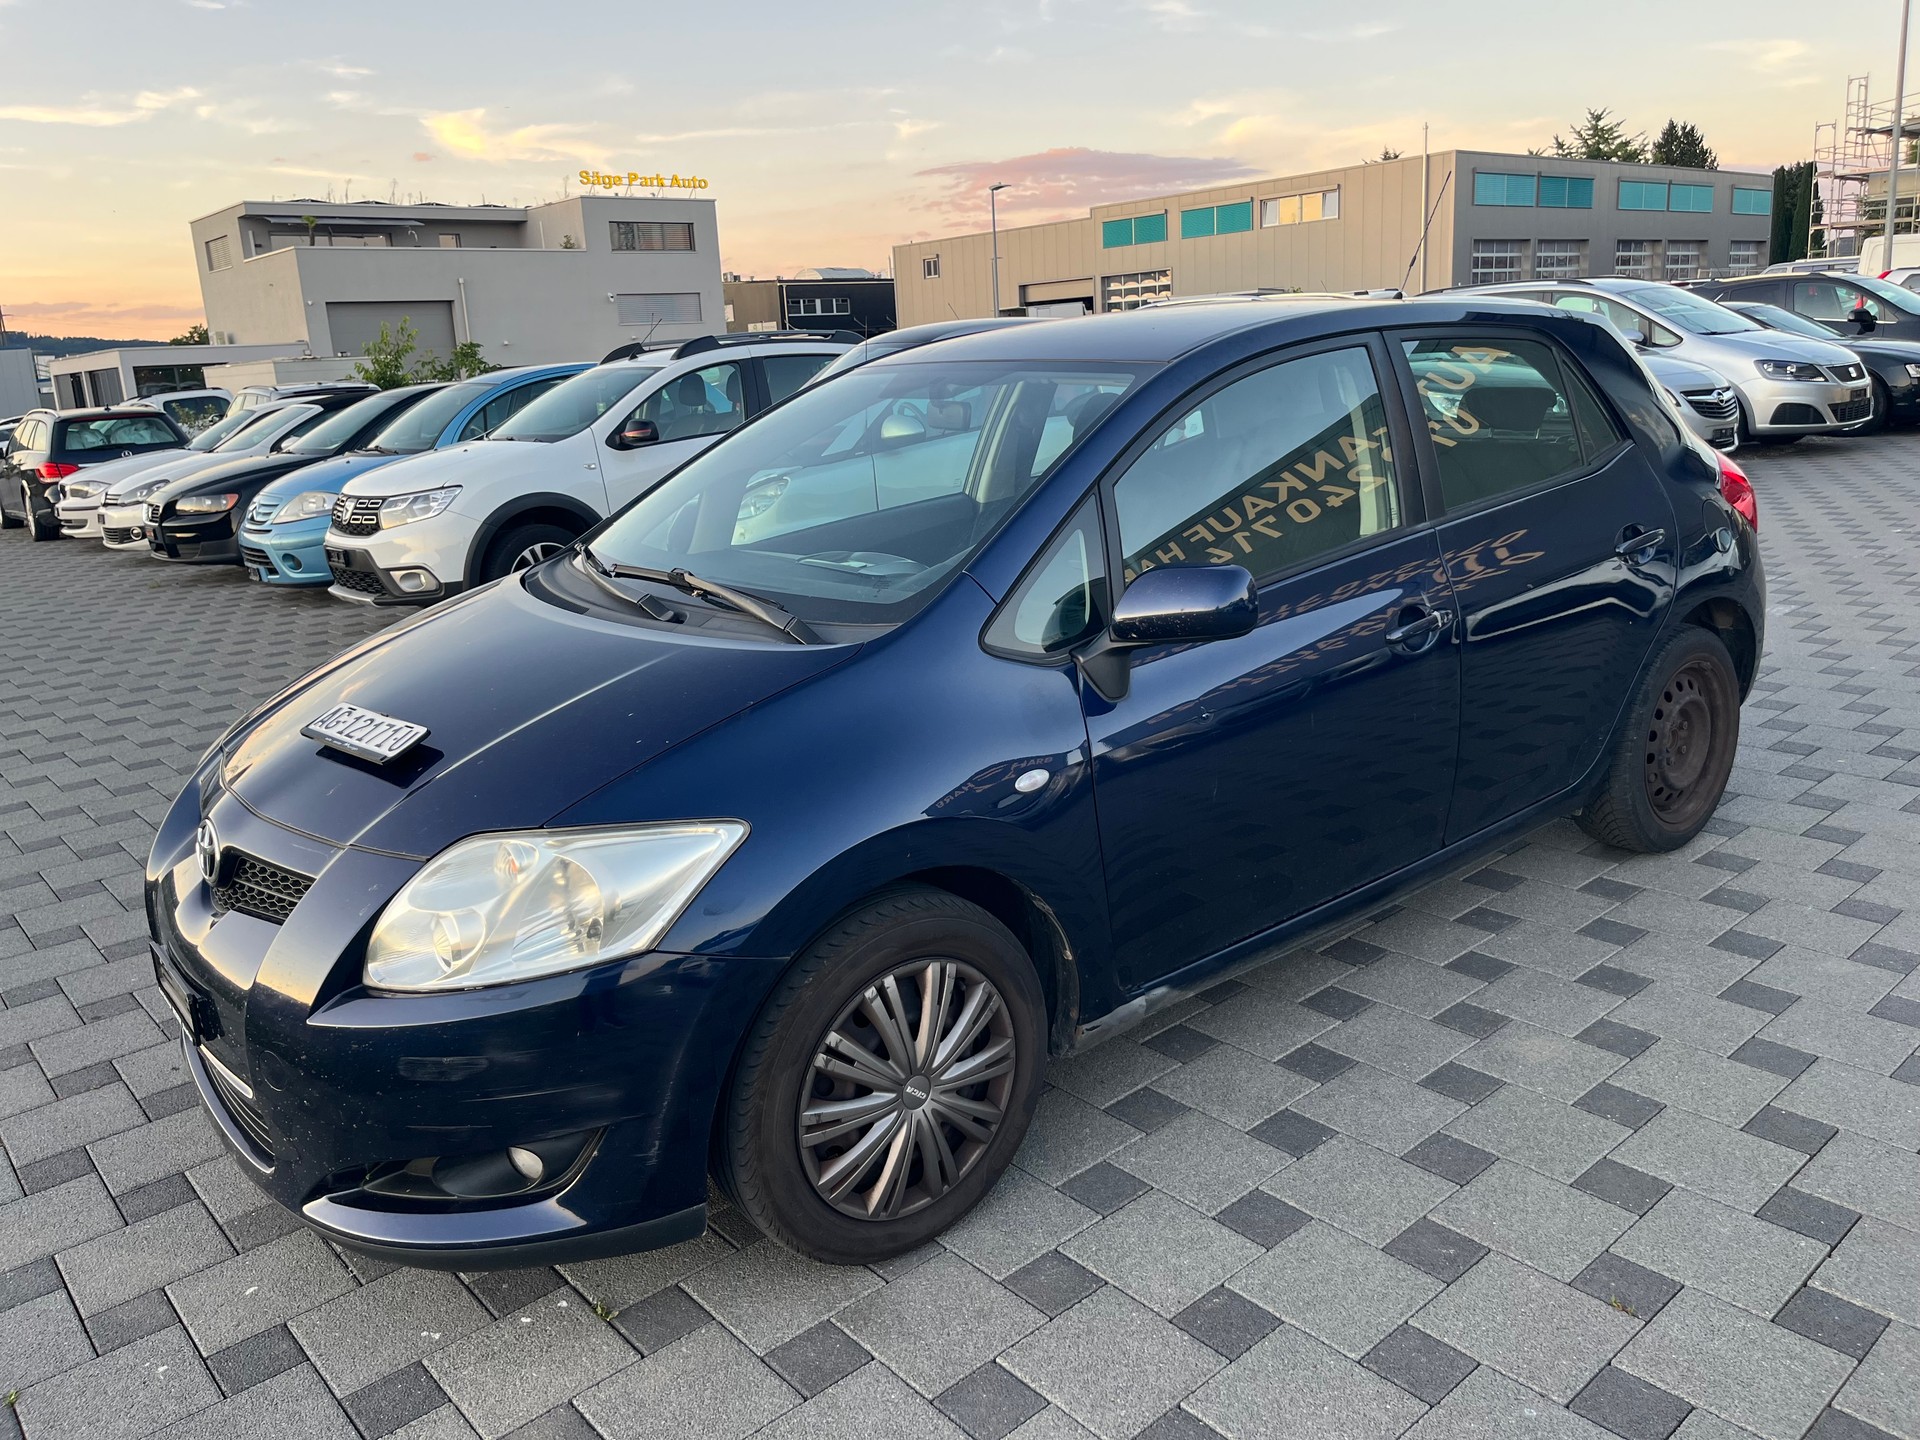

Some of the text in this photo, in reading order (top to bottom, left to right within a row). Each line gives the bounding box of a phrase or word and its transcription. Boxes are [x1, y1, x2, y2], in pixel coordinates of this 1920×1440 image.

[579, 170, 709, 190] Säge Park Auto
